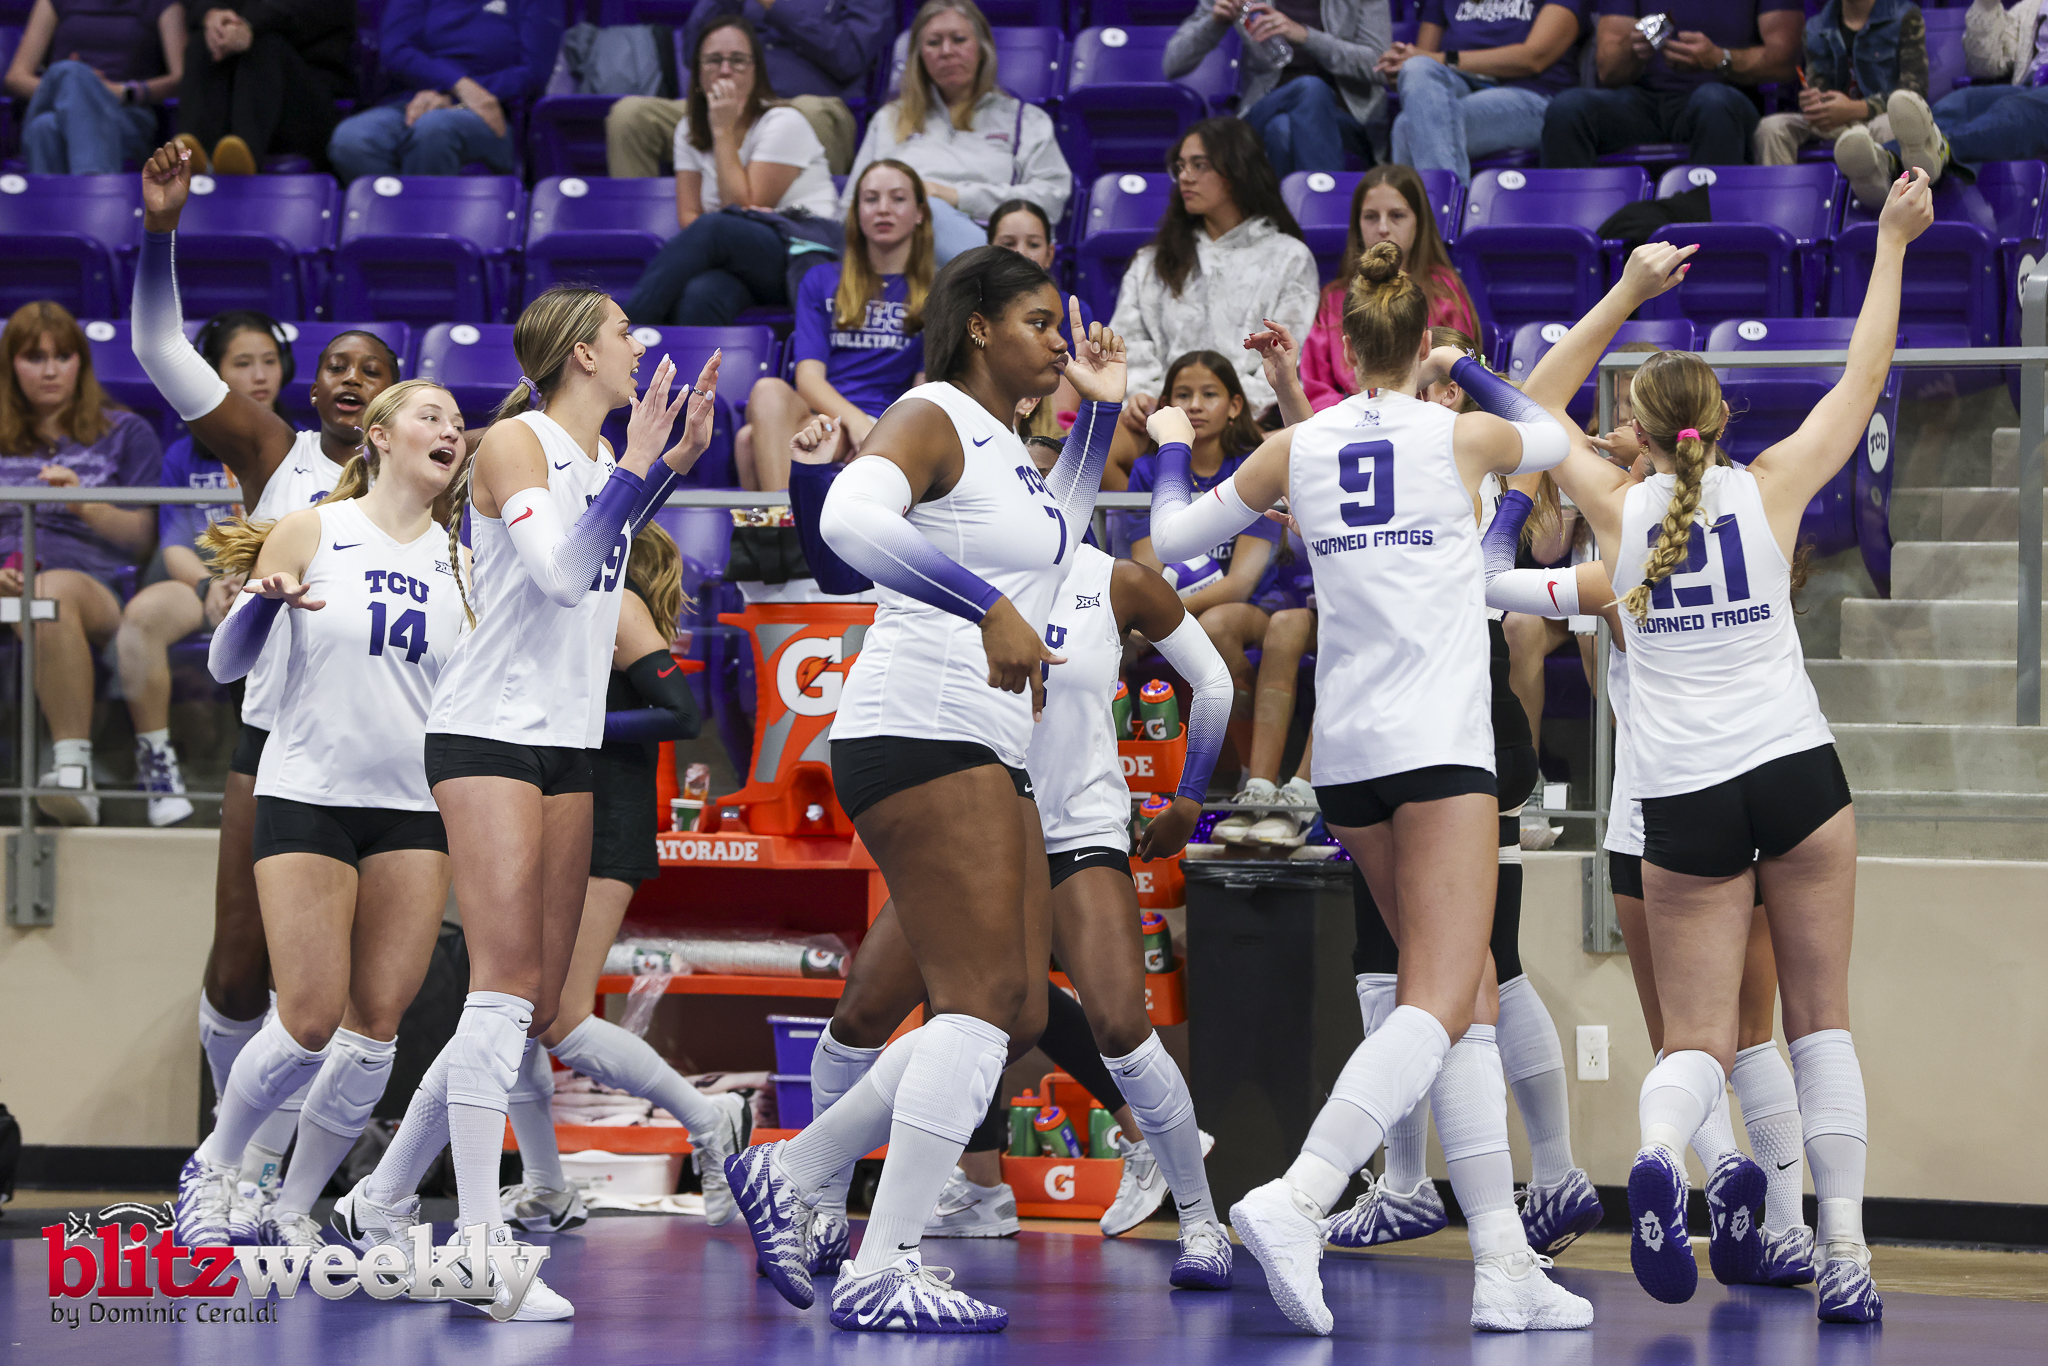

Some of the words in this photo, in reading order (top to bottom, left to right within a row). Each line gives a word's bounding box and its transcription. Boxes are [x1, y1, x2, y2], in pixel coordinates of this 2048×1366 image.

[1870, 431, 1887, 455] TCU
[1338, 439, 1395, 527] 9
[1312, 533, 1367, 557] HORNED
[1374, 530, 1433, 547] FROGS
[1647, 513, 1750, 609] 21
[588, 533, 627, 592] 9
[365, 570, 429, 604] TCU
[367, 601, 429, 665] 14
[1712, 603, 1771, 628] FROGS
[776, 636, 844, 716] G
[1146, 717, 1167, 740] G
[656, 840, 759, 862] ATORADE
[1044, 1165, 1075, 1201] G
